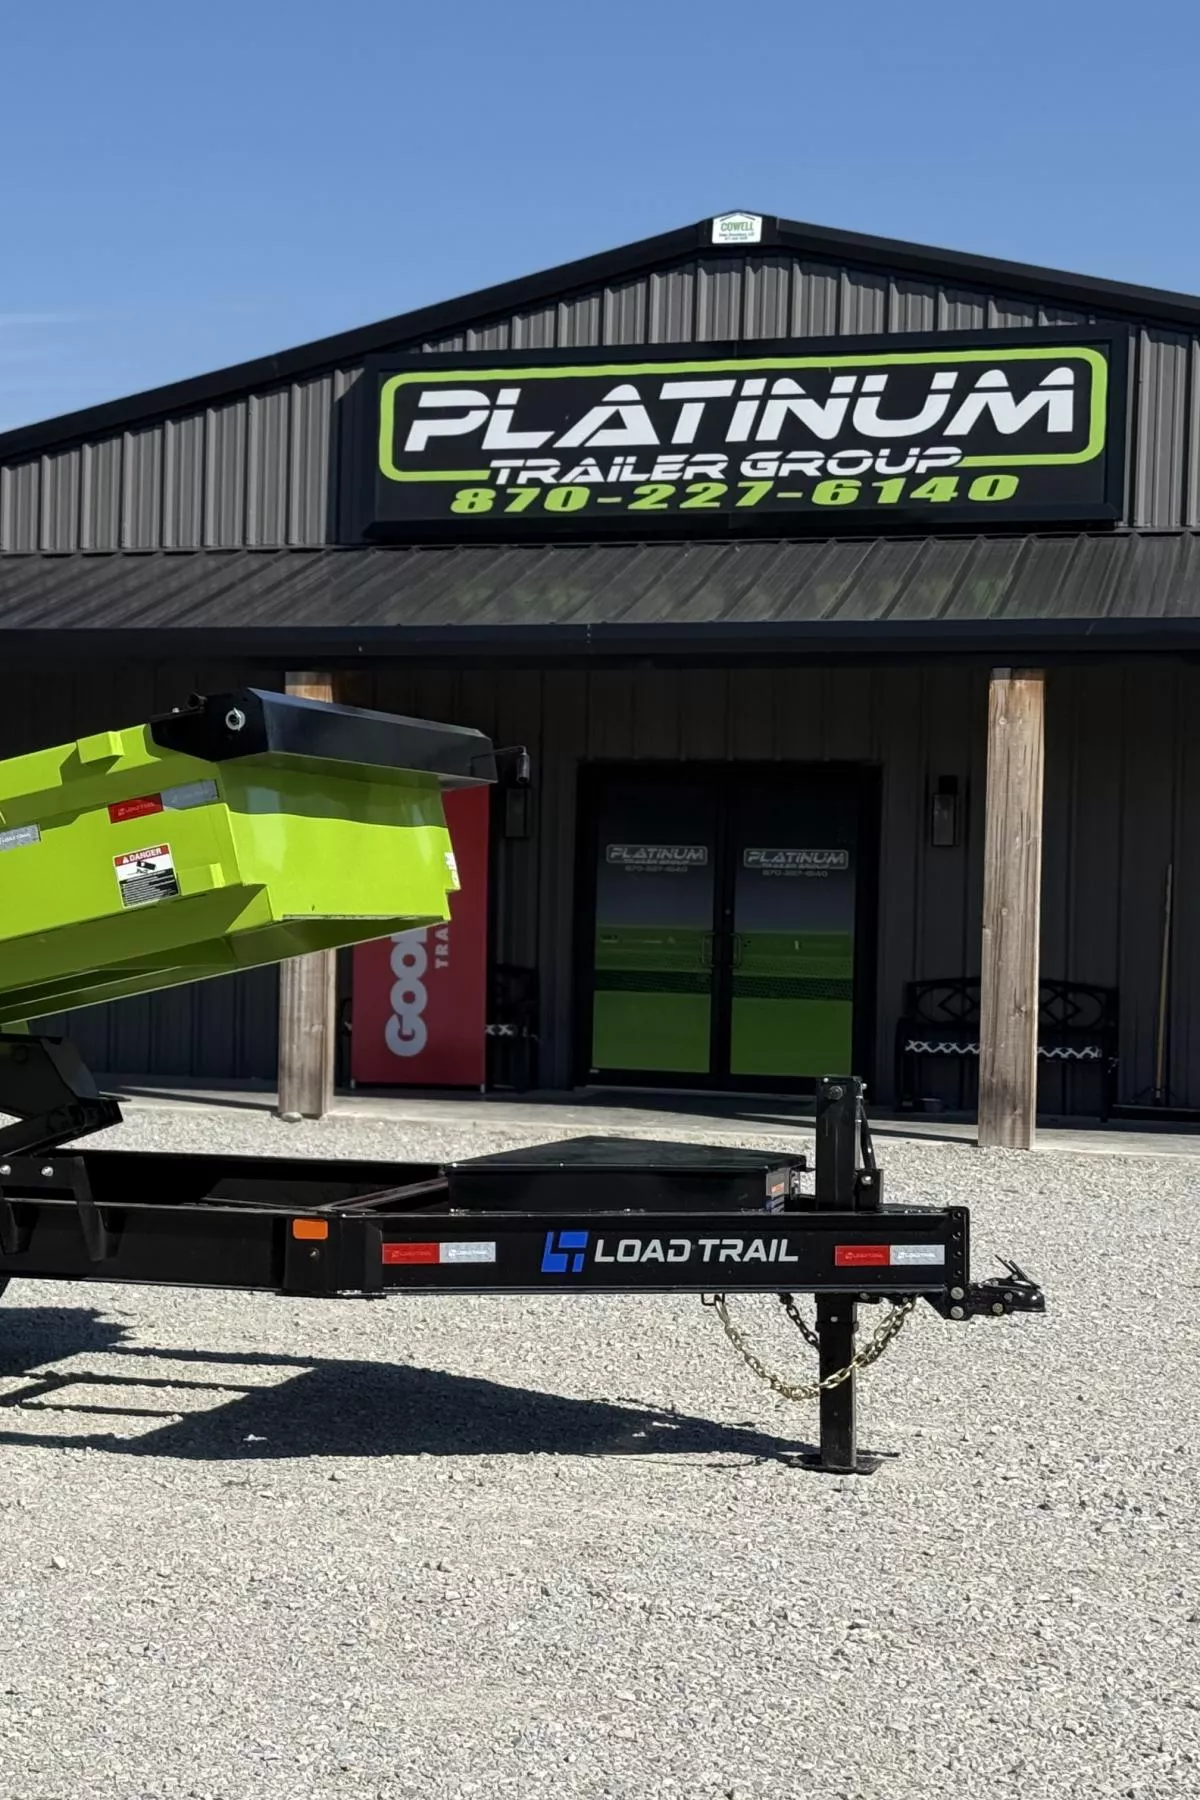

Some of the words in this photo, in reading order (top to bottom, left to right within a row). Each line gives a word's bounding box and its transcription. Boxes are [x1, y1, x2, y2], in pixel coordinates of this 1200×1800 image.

[720, 222, 754, 231] COWELL
[404, 367, 1075, 451] PLATINUM
[489, 453, 729, 485] TRAILER
[740, 446, 963, 478] GROUP
[450, 474, 1020, 513] 870-227-6140
[128, 848, 162, 861] DANGER
[610, 847, 703, 860] PLATINUM
[747, 851, 845, 864] PLATINUM
[594, 1239, 692, 1262] LOAD
[697, 1239, 799, 1262] TRAIL
